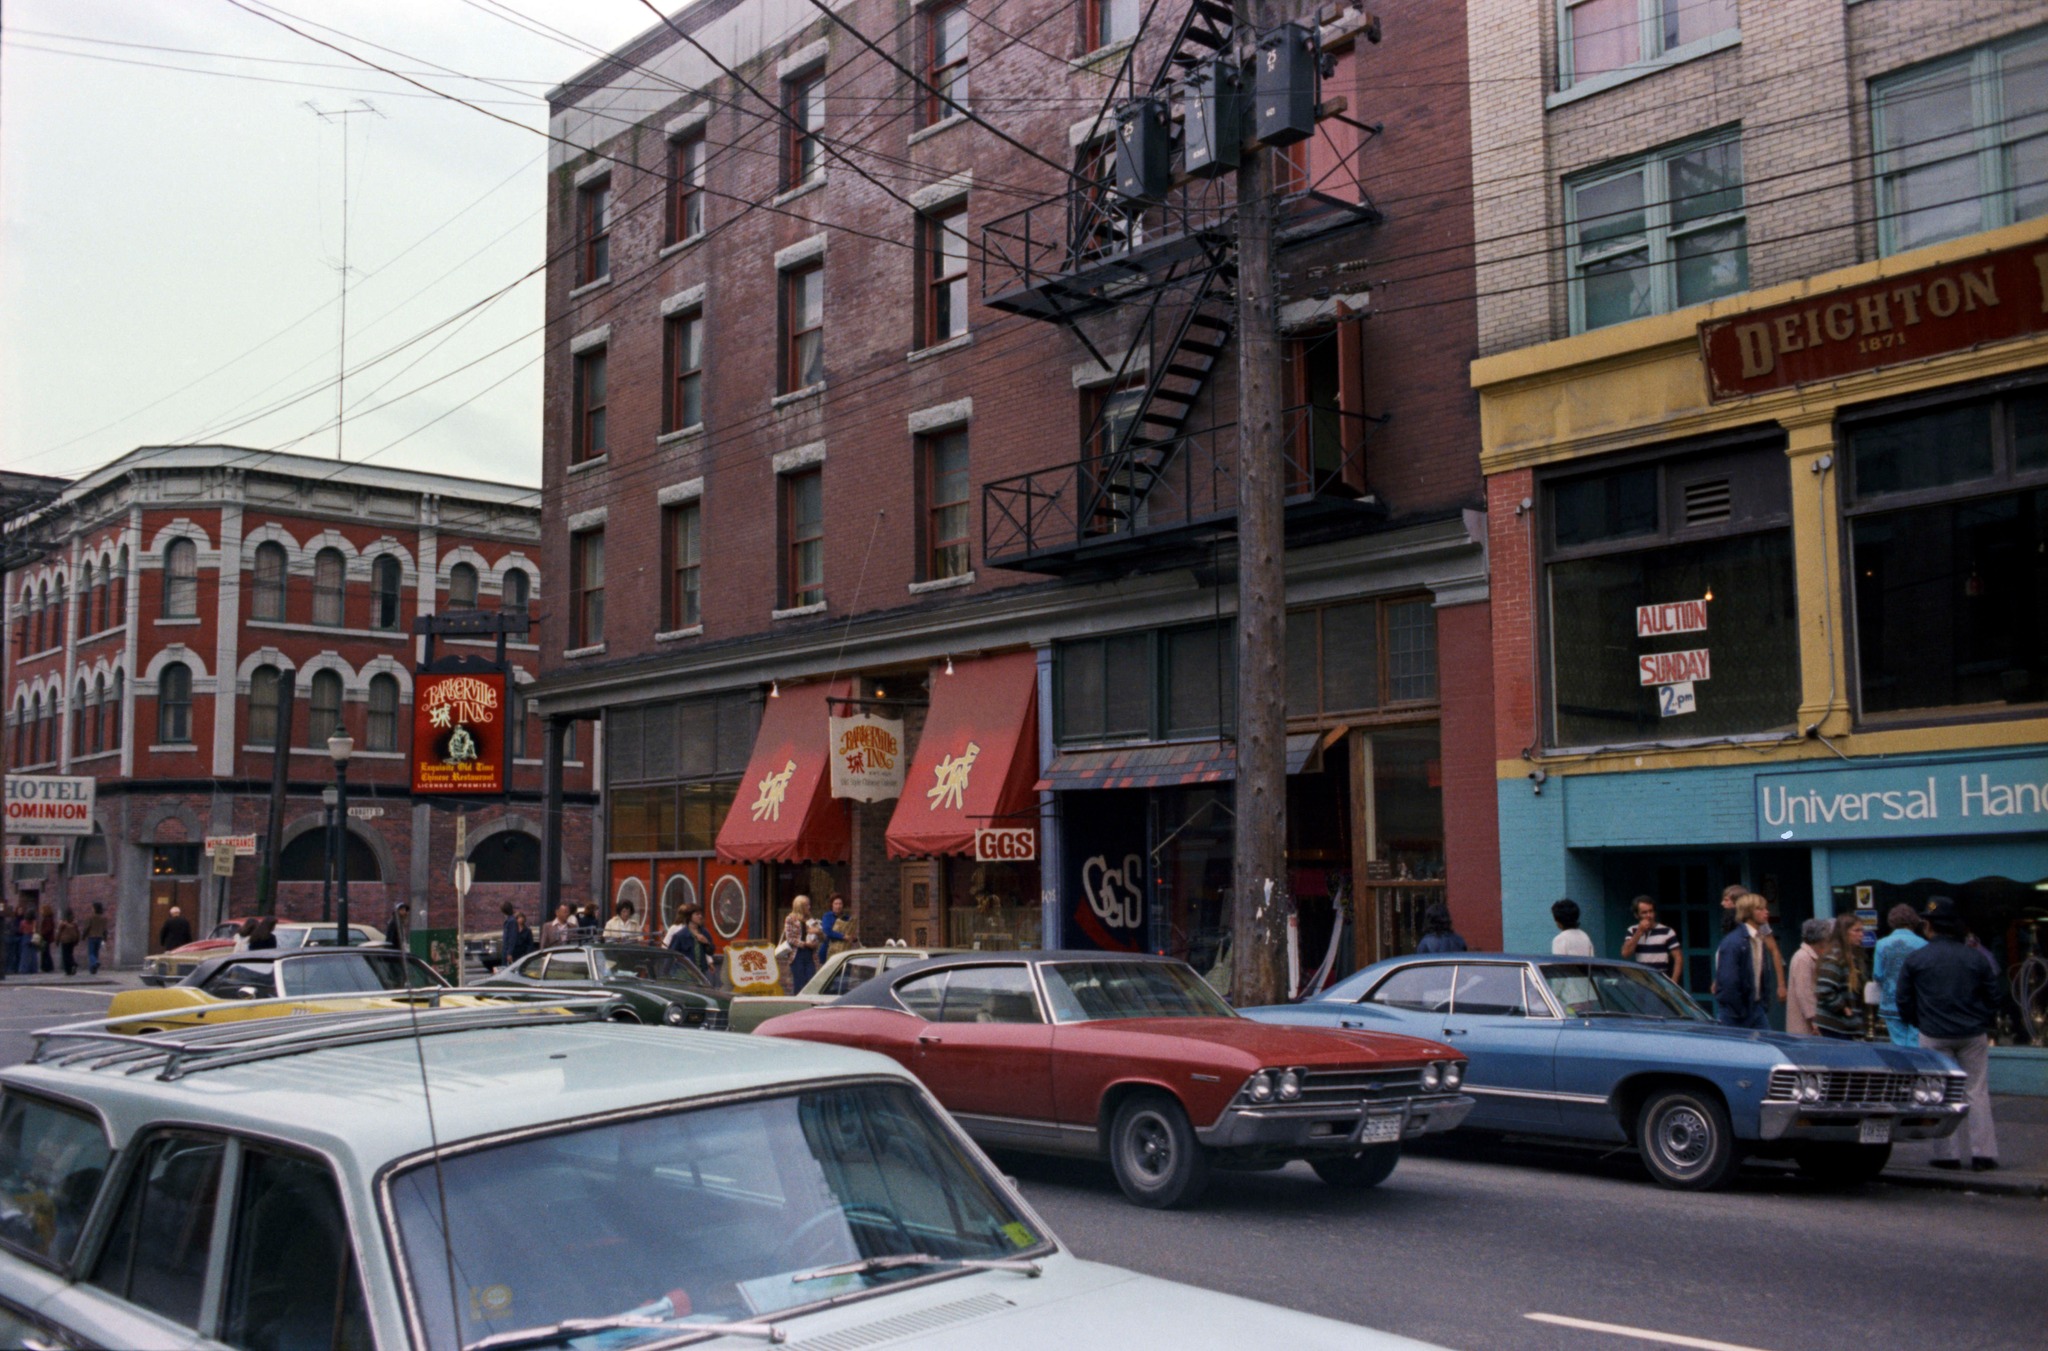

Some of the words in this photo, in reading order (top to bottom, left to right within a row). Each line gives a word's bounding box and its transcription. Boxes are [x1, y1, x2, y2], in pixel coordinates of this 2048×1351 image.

[1266, 49, 1276, 64] 25
[1123, 122, 1134, 136] 25
[1735, 265, 2000, 379] DEIGHTON
[1858, 332, 1906, 353] 1871
[1638, 601, 1706, 634] AUCTION
[1641, 650, 1709, 684] SUNDAY
[453, 701, 493, 723] INN
[421, 762, 454, 775] Exquisite
[457, 762, 472, 771] Old
[476, 762, 494, 771] Time
[864, 747, 894, 770] INN
[421, 772, 449, 782] Chinese
[452, 772, 494, 781] Restaurant
[5, 780, 88, 801] HOTEL
[1763, 776, 1938, 826] Universal
[3, 802, 88, 820] OMINION
[14, 848, 62, 858] ESCORTS
[225, 837, 255, 848] ENTRANCE
[979, 832, 1032, 860] GGS
